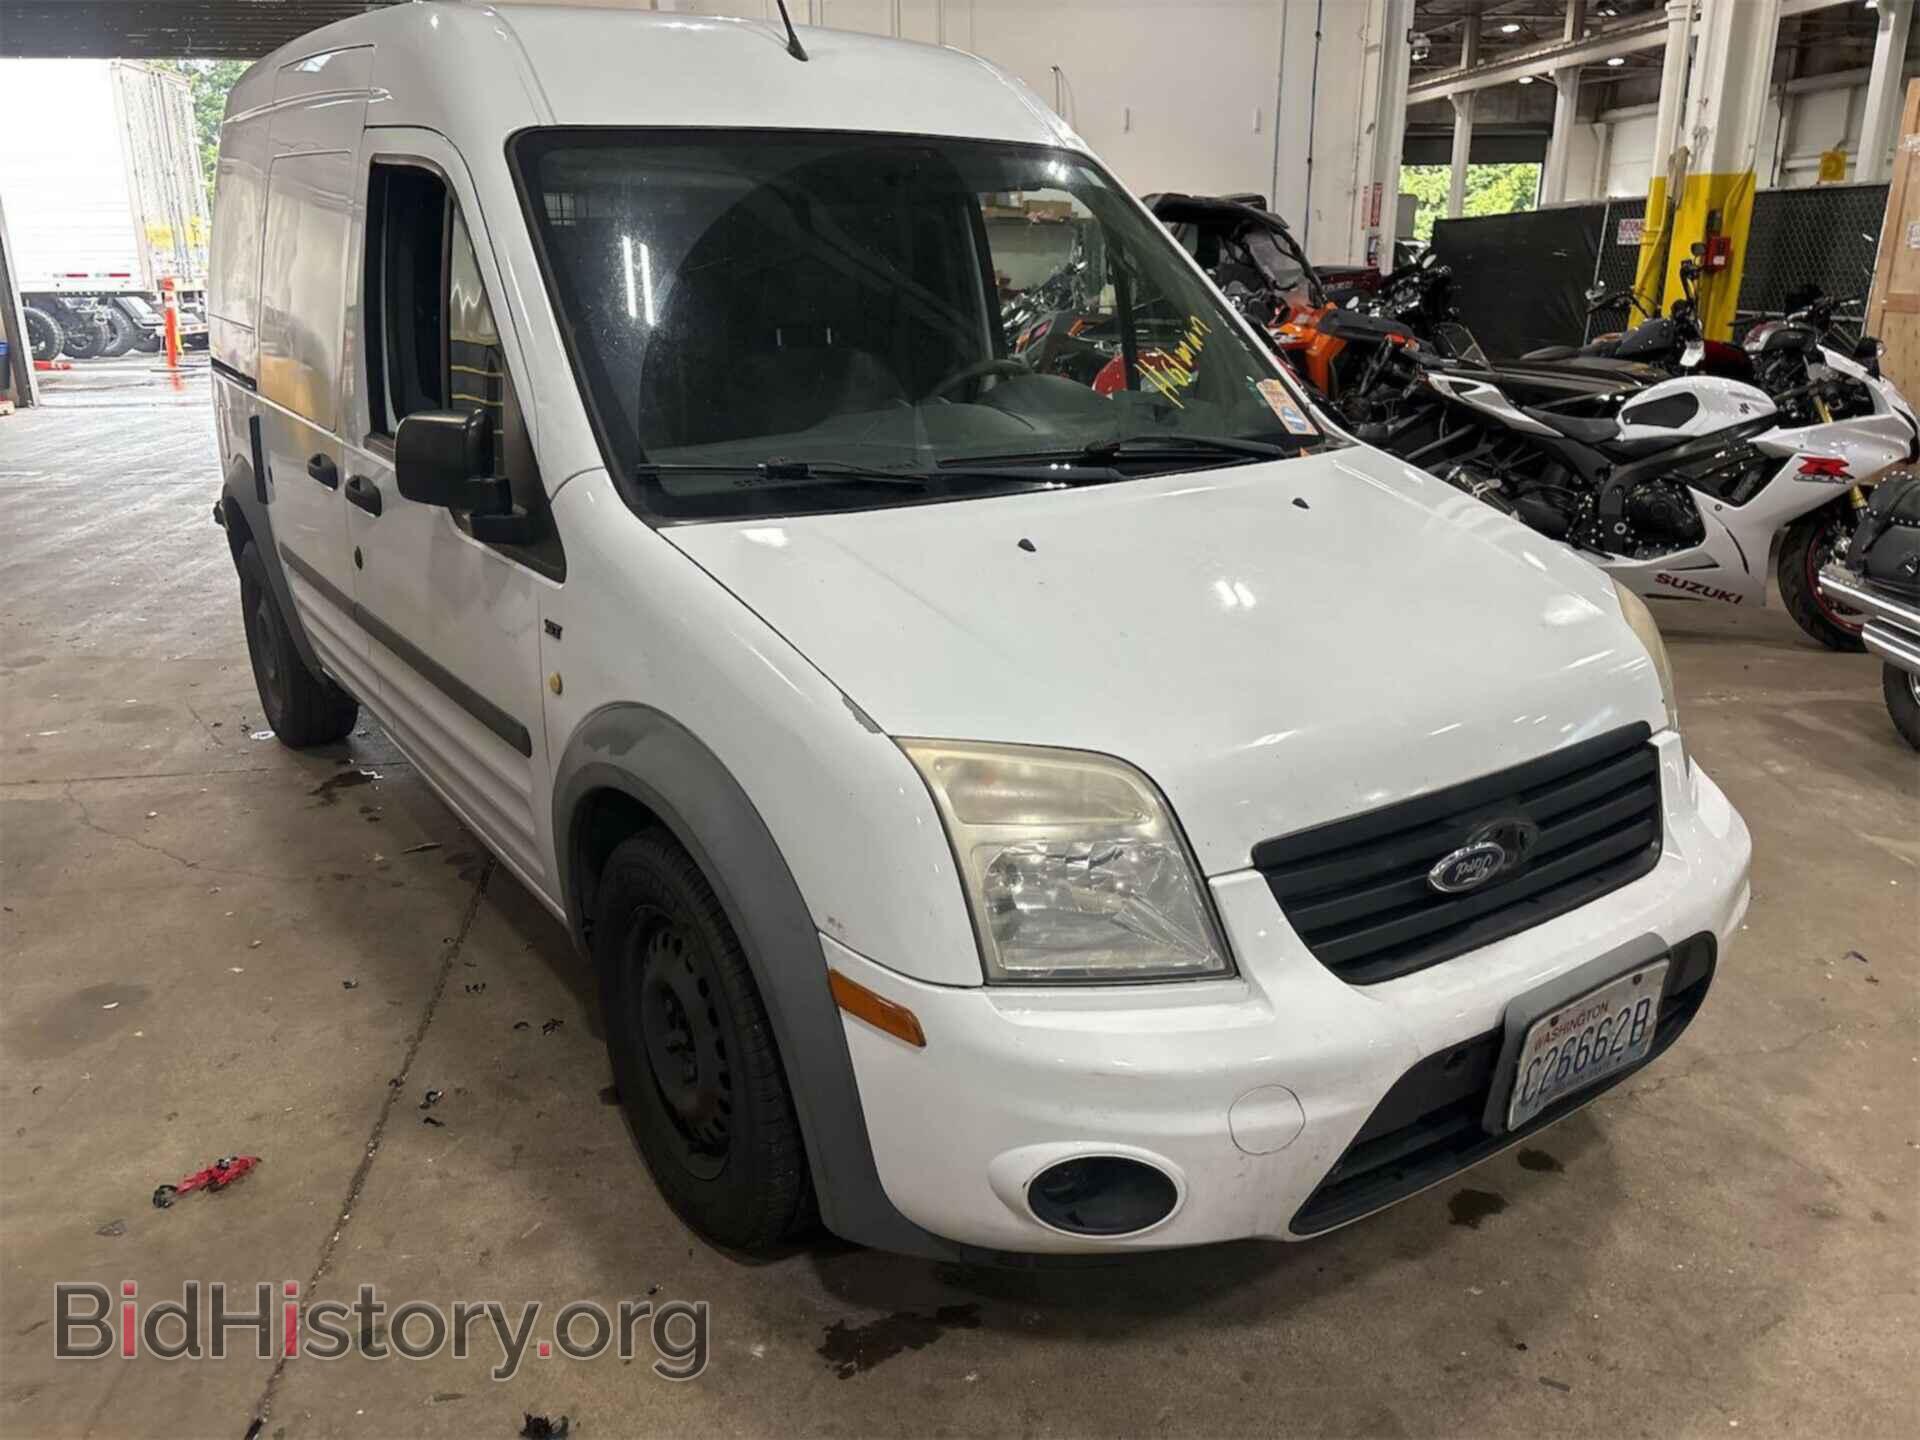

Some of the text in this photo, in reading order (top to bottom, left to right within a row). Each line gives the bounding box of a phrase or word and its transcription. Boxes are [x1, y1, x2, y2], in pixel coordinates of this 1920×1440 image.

[1654, 573, 1744, 605] SUZUKI
[1520, 997, 1651, 1105] C26662B
[1533, 999, 1609, 1051] WASHINGTON
